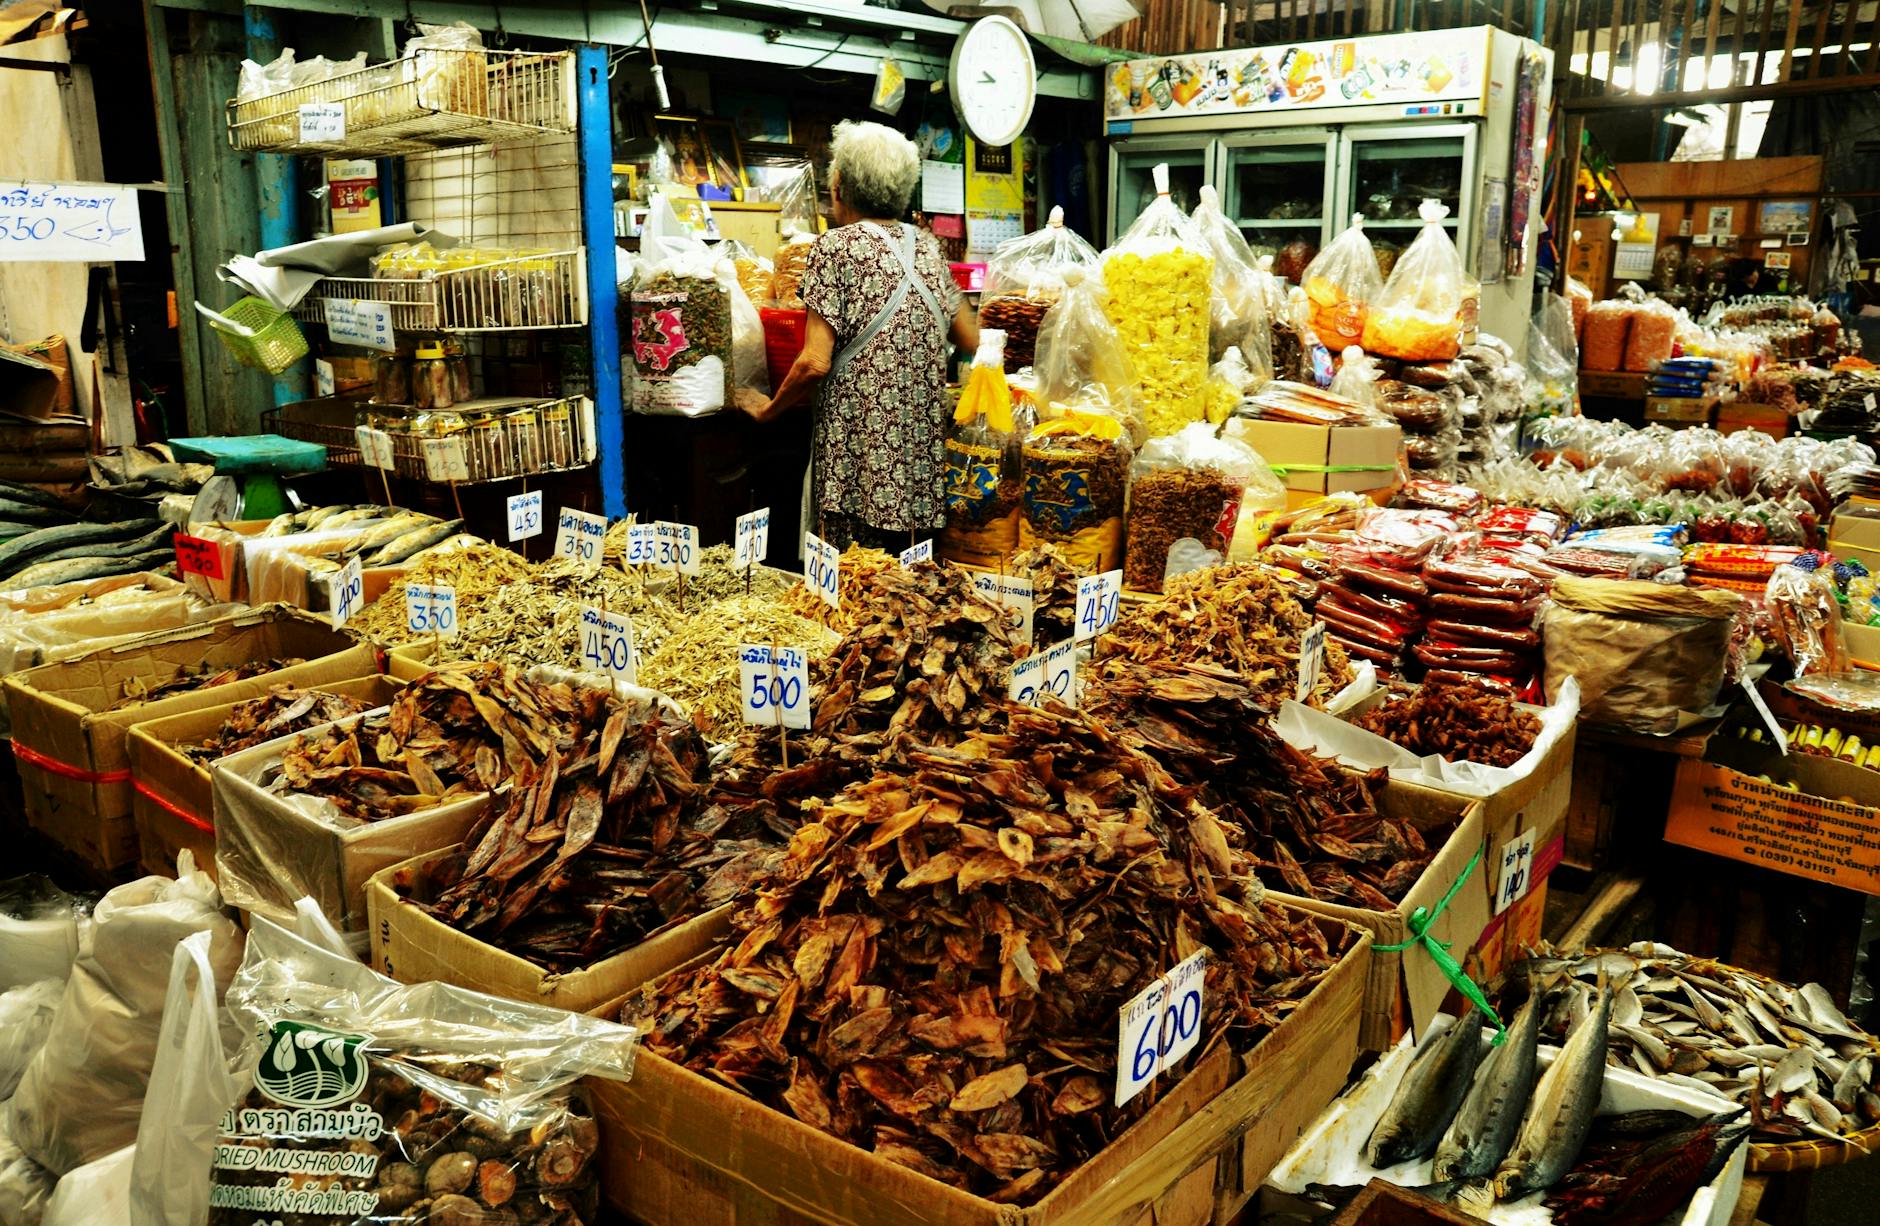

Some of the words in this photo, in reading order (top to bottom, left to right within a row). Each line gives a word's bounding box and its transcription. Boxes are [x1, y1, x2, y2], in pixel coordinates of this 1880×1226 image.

[514, 512, 538, 532] 450
[564, 536, 594, 559] 350
[629, 540, 656, 560] 35
[660, 541, 690, 565] 300
[809, 556, 836, 594] 400
[338, 577, 361, 620] 400
[1082, 590, 1120, 633] 450
[410, 604, 454, 631] 350
[586, 630, 628, 671] 450
[750, 673, 801, 710] 500
[1797, 858, 1837, 876] 431151
[1132, 990, 1200, 1082] 600
[244, 1110, 290, 1132] ตรา
[298, 1104, 381, 1138] สามบัว
[261, 1148, 376, 1175] MUSHROOM
